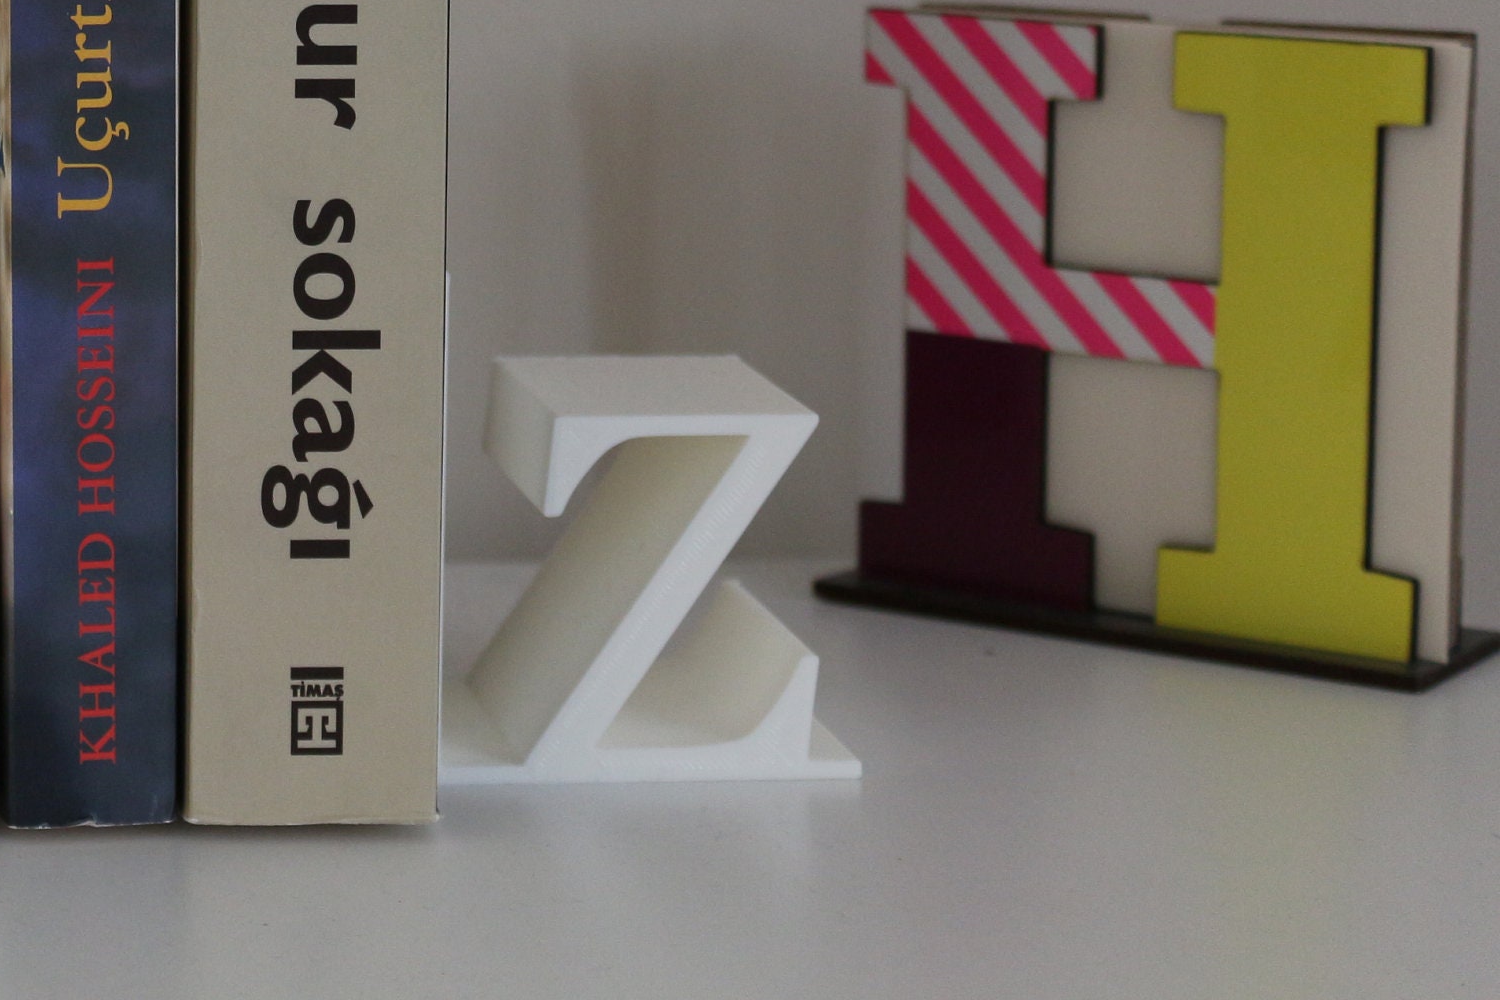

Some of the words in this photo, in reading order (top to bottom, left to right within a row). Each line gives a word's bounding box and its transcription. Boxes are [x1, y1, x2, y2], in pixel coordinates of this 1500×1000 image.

[77, 256, 116, 515] HOSSEINI
[77, 532, 117, 763] KHALED
[490, 355, 820, 781] Z
[290, 681, 345, 702] TİMAŞ
